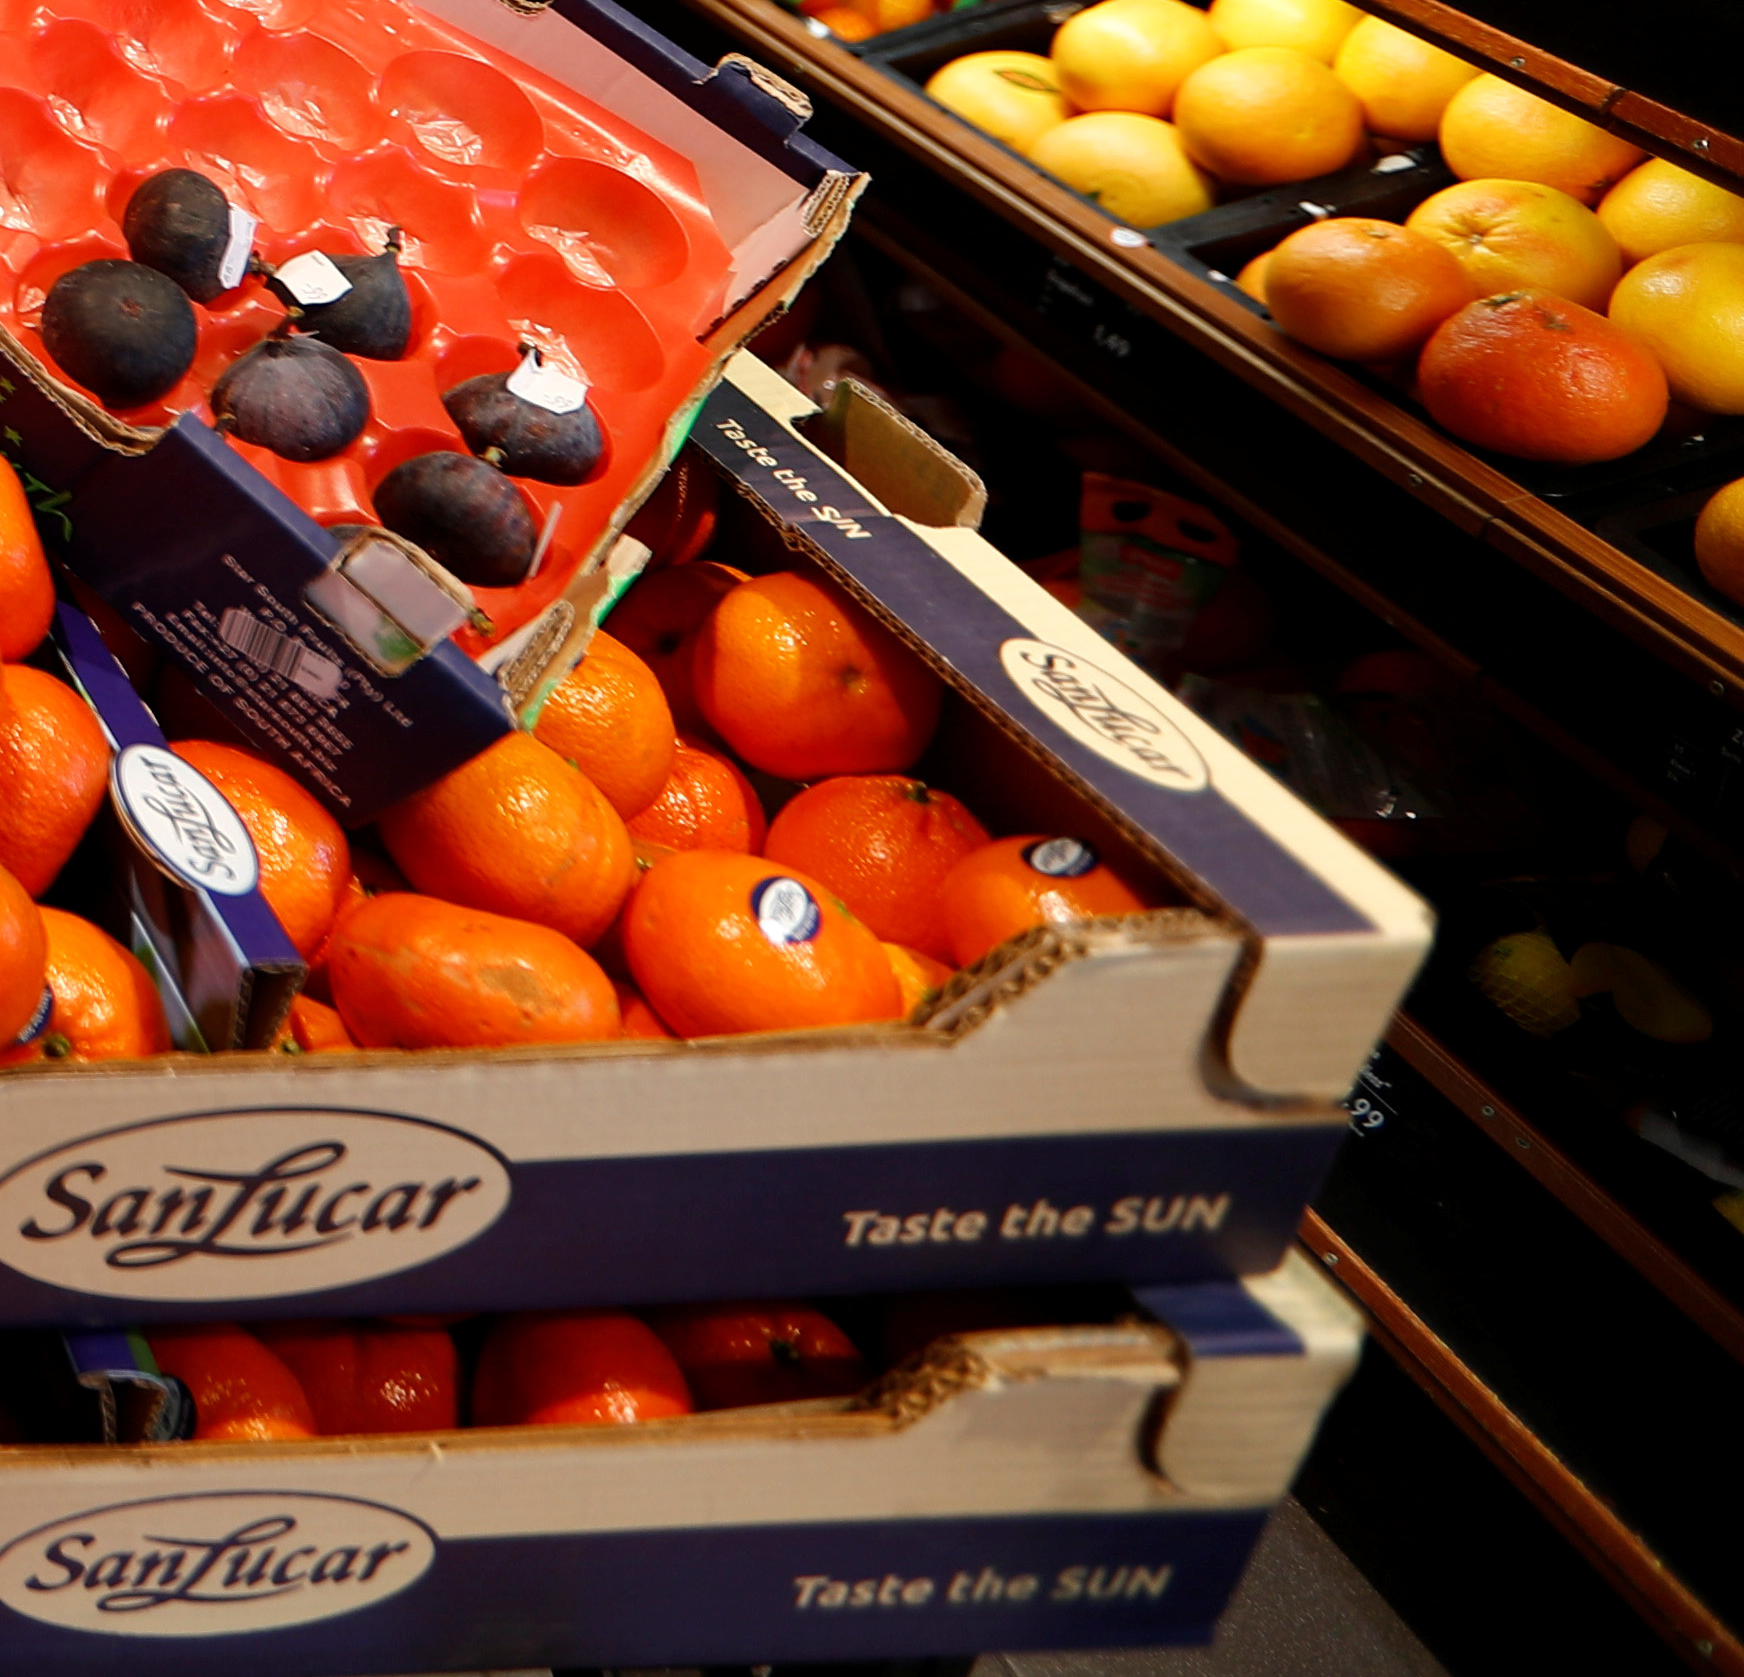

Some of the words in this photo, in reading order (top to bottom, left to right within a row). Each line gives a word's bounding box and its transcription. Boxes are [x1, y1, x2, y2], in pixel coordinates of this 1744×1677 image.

[715, 418, 778, 469] Taste
[772, 464, 820, 505] the
[131, 601, 210, 674] PRODUCE
[207, 671, 235, 698] OF
[233, 696, 291, 751] SOUTH
[289, 747, 354, 808] AFRICA
[221, 553, 257, 587] Star
[253, 582, 301, 627] South
[298, 624, 348, 670] Fruits
[343, 665, 385, 705] (Pty)
[381, 700, 413, 729] Ltd
[1019, 649, 1193, 783] SanLucar
[137, 753, 239, 885] SanLucar
[19, 1140, 484, 1271] SanLucar
[842, 1208, 994, 1247] Taste
[1001, 1202, 1098, 1242] the
[1106, 1193, 1230, 1236] SUN
[24, 1513, 413, 1612] SanLucar
[793, 1575, 940, 1611] Taste
[944, 1568, 1040, 1606] the
[1045, 1562, 1172, 1601] SUN
